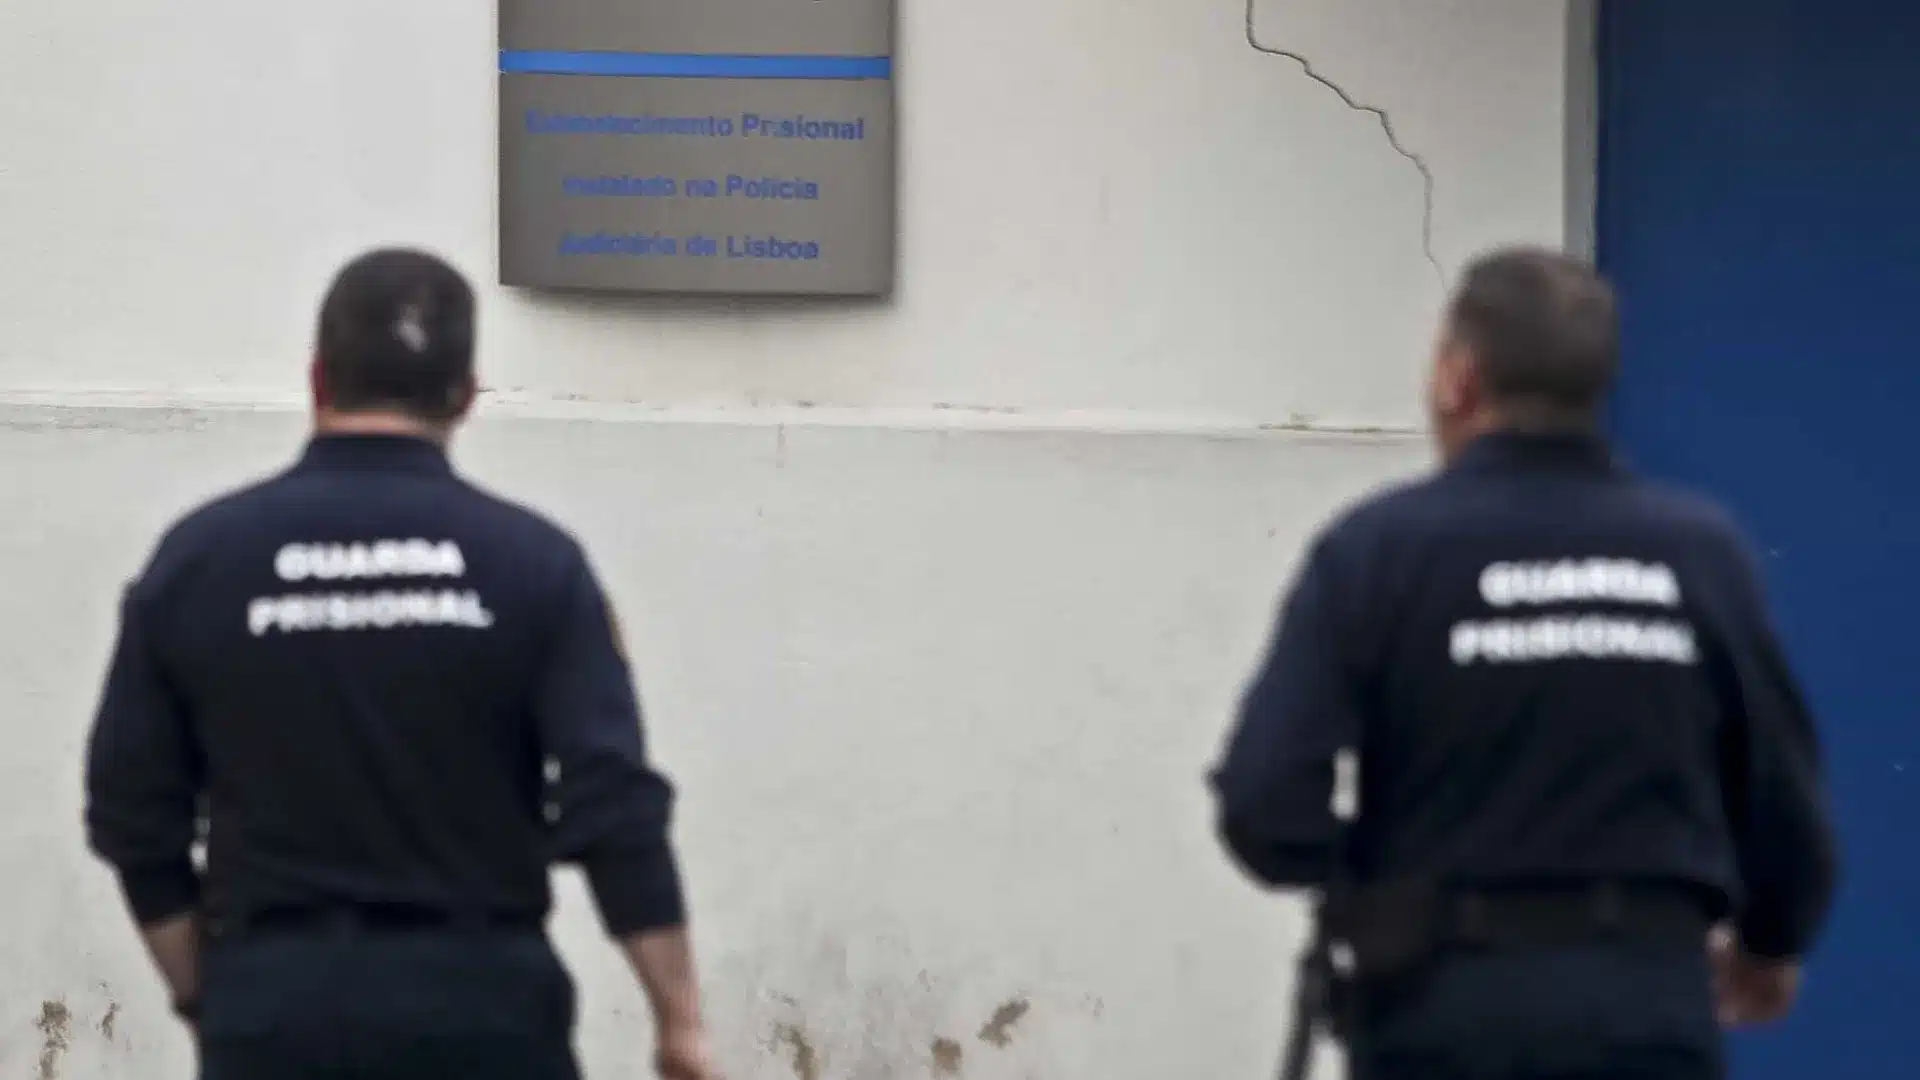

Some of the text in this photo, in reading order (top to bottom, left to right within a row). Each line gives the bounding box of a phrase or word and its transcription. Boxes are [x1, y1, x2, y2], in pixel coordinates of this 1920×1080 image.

[741, 112, 865, 141] Prisional
[686, 181, 717, 198] na
[686, 234, 716, 257] de
[727, 236, 819, 260] Lisboa
[275, 538, 465, 581] GUARDA
[1479, 557, 1681, 607] GUARDA
[248, 590, 494, 635] PRISIONAL
